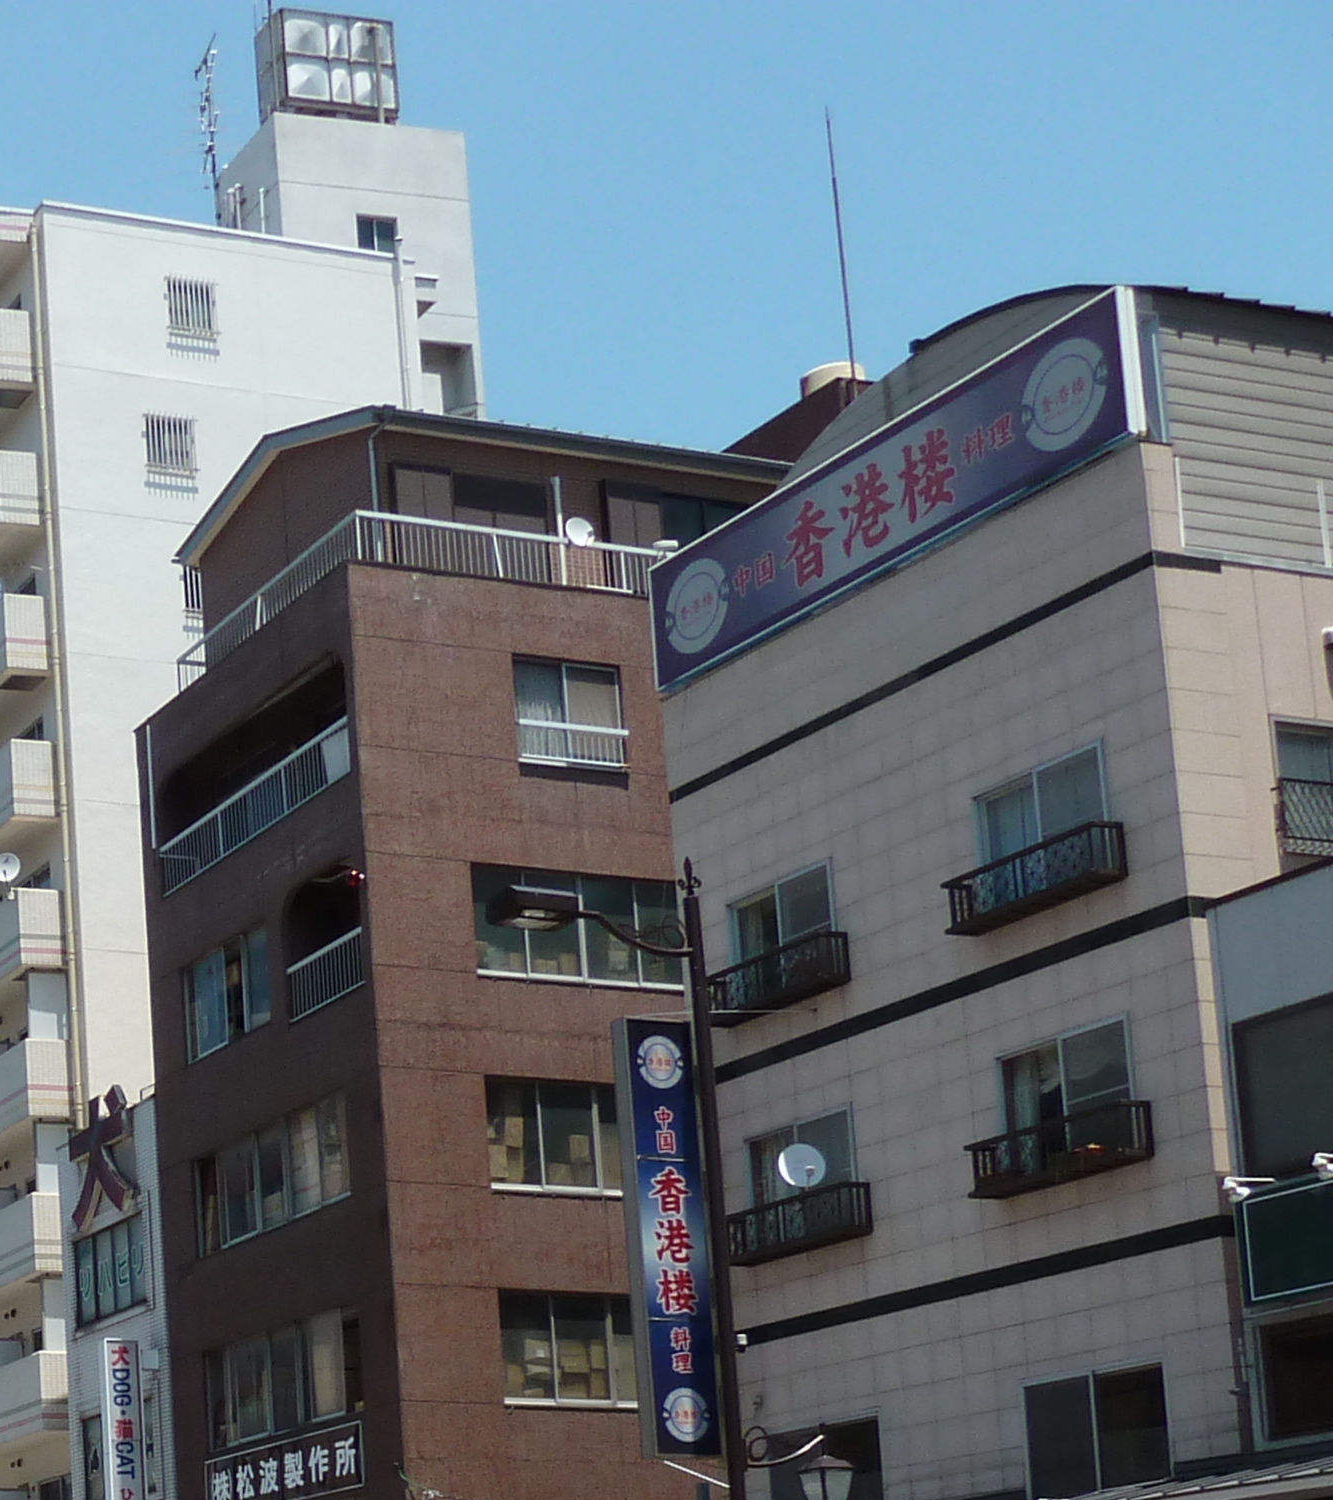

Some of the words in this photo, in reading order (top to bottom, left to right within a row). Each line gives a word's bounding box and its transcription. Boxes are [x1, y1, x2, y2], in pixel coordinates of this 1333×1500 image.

[733, 551, 775, 596] 中国
[782, 427, 956, 588] 香港楼
[961, 414, 1014, 464] 料理
[69, 1085, 127, 1231] 犬
[653, 1106, 677, 1154] 中国
[79, 1243, 144, 1301] リハビリ
[649, 1165, 698, 1316] 香港楼
[670, 1326, 693, 1374] 料理
